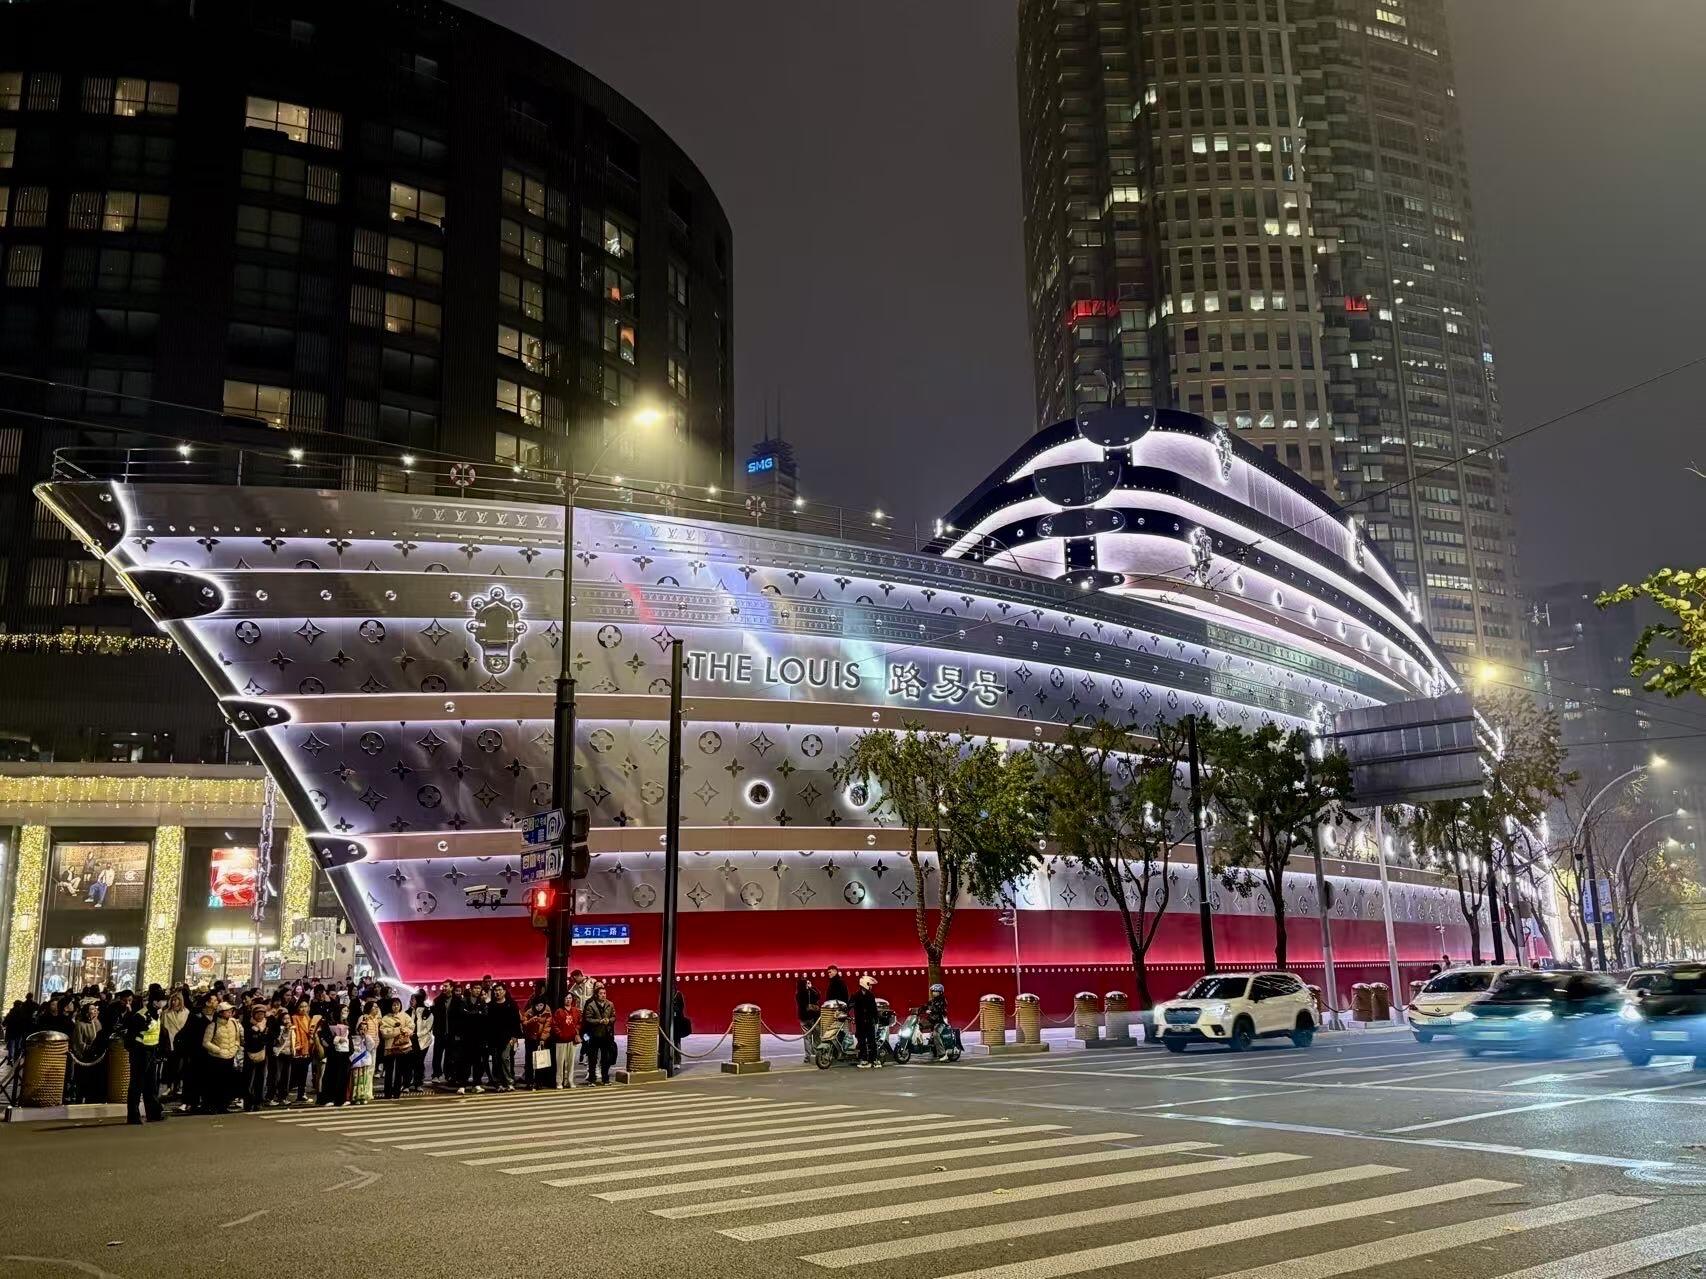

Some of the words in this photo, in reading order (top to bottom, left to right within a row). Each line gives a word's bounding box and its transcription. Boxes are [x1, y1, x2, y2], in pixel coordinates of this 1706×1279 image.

[748, 458, 773, 473] SMG
[689, 652, 751, 681] THE
[765, 656, 861, 689] LOUIS
[888, 661, 1006, 706] 路易号
[584, 928, 617, 937] 石门一路
